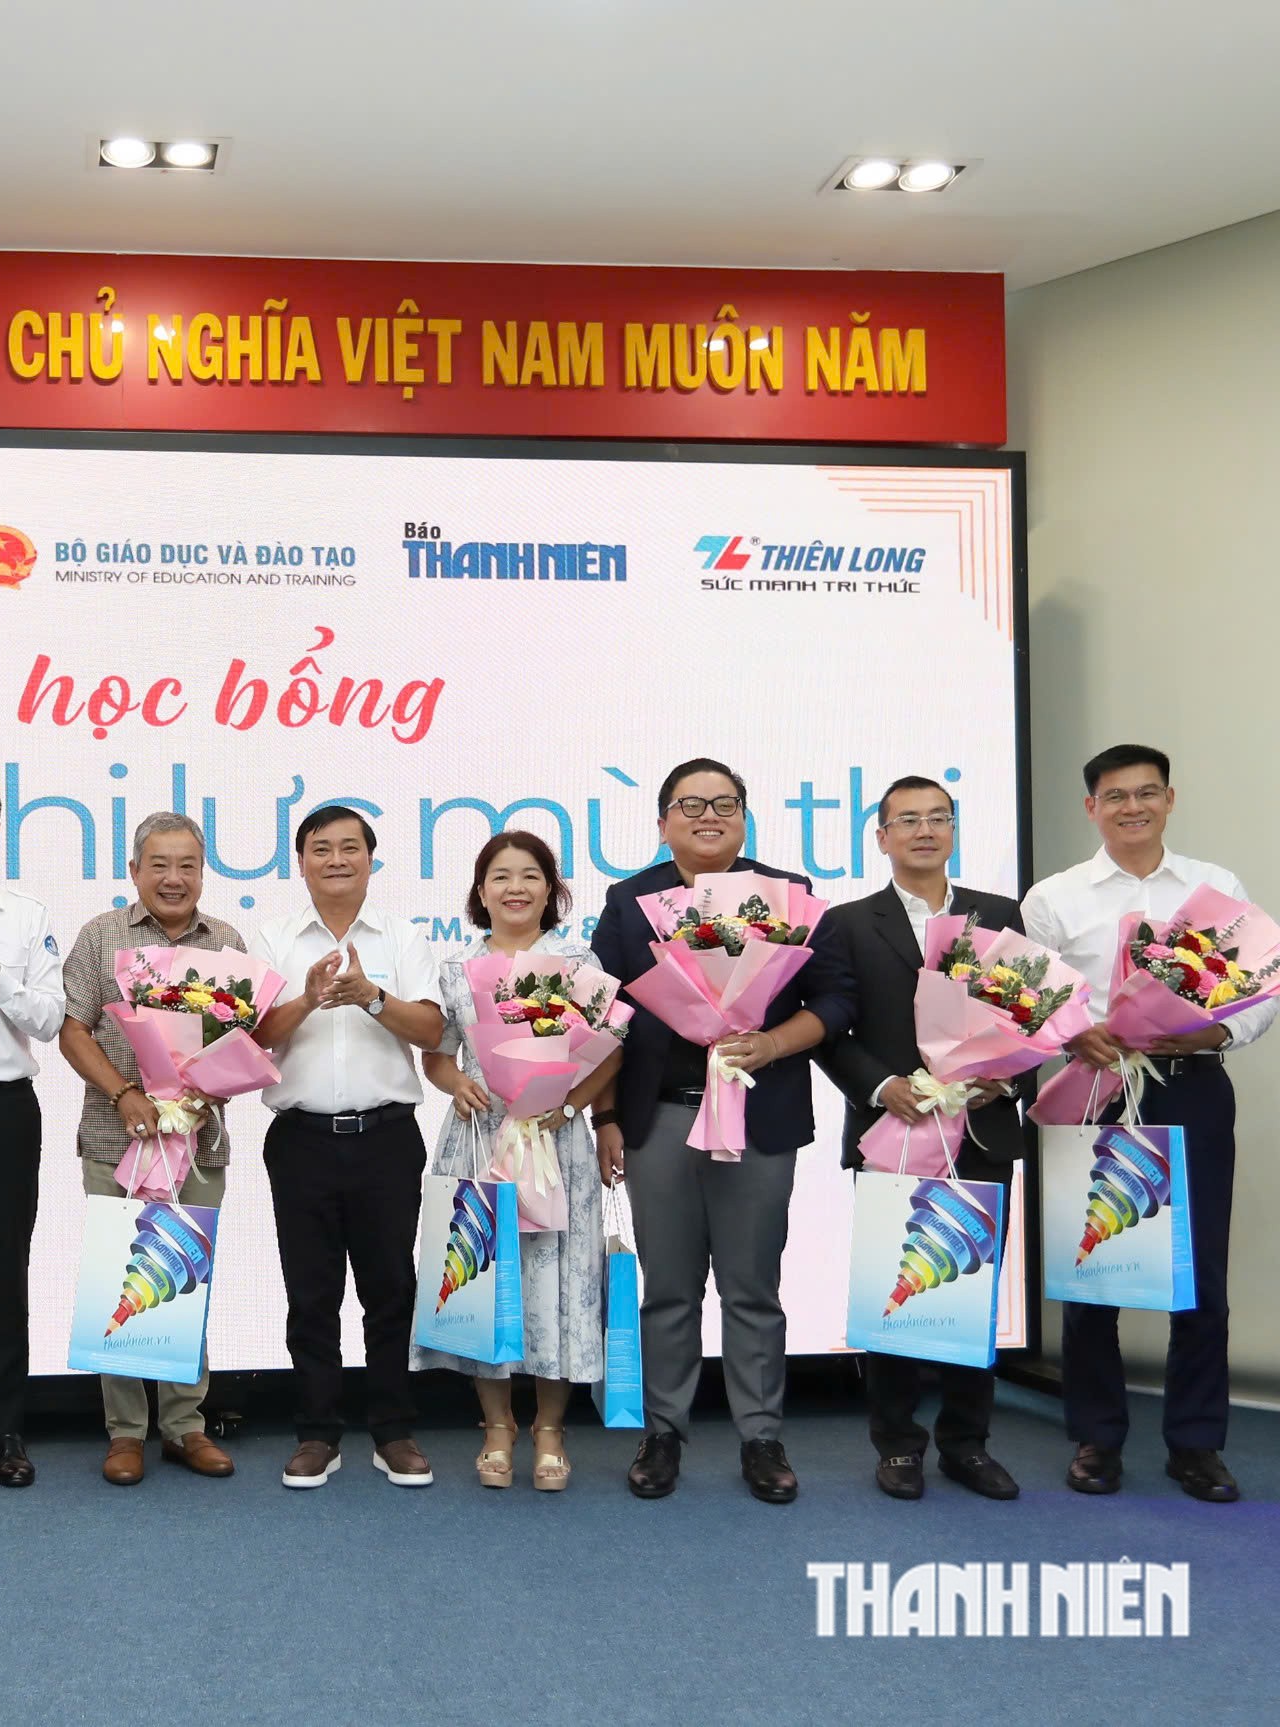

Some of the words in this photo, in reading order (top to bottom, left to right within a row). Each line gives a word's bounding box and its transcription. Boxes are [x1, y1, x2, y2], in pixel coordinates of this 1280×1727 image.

[7, 286, 125, 382] CHỦ
[147, 297, 321, 384] NGHĨA
[336, 299, 462, 399] VIỆT
[482, 319, 604, 388] NAM
[625, 304, 785, 393] MUÔN
[804, 311, 928, 394] NĂM
[404, 522, 441, 539] Báo
[55, 538, 87, 567] BỘ
[96, 540, 151, 564] GIÁO
[161, 544, 208, 568] DỤC
[217, 540, 248, 565] VÀ
[255, 542, 303, 566] ĐÀO
[312, 546, 356, 570] TẠO
[761, 540, 845, 571] THIÊN
[848, 547, 926, 573] LONG
[56, 570, 122, 583] MINISTRY
[127, 571, 148, 583] OF
[153, 572, 241, 585] EDUCATION
[246, 573, 281, 585] AND
[285, 574, 356, 586] TRAINING
[701, 576, 743, 591] SỨC
[749, 580, 816, 592] MẠNH
[823, 581, 856, 592] TRI
[863, 579, 920, 593] THỨC
[18, 653, 188, 740] học
[214, 626, 445, 745] bổng
[419, 766, 756, 880] mù
